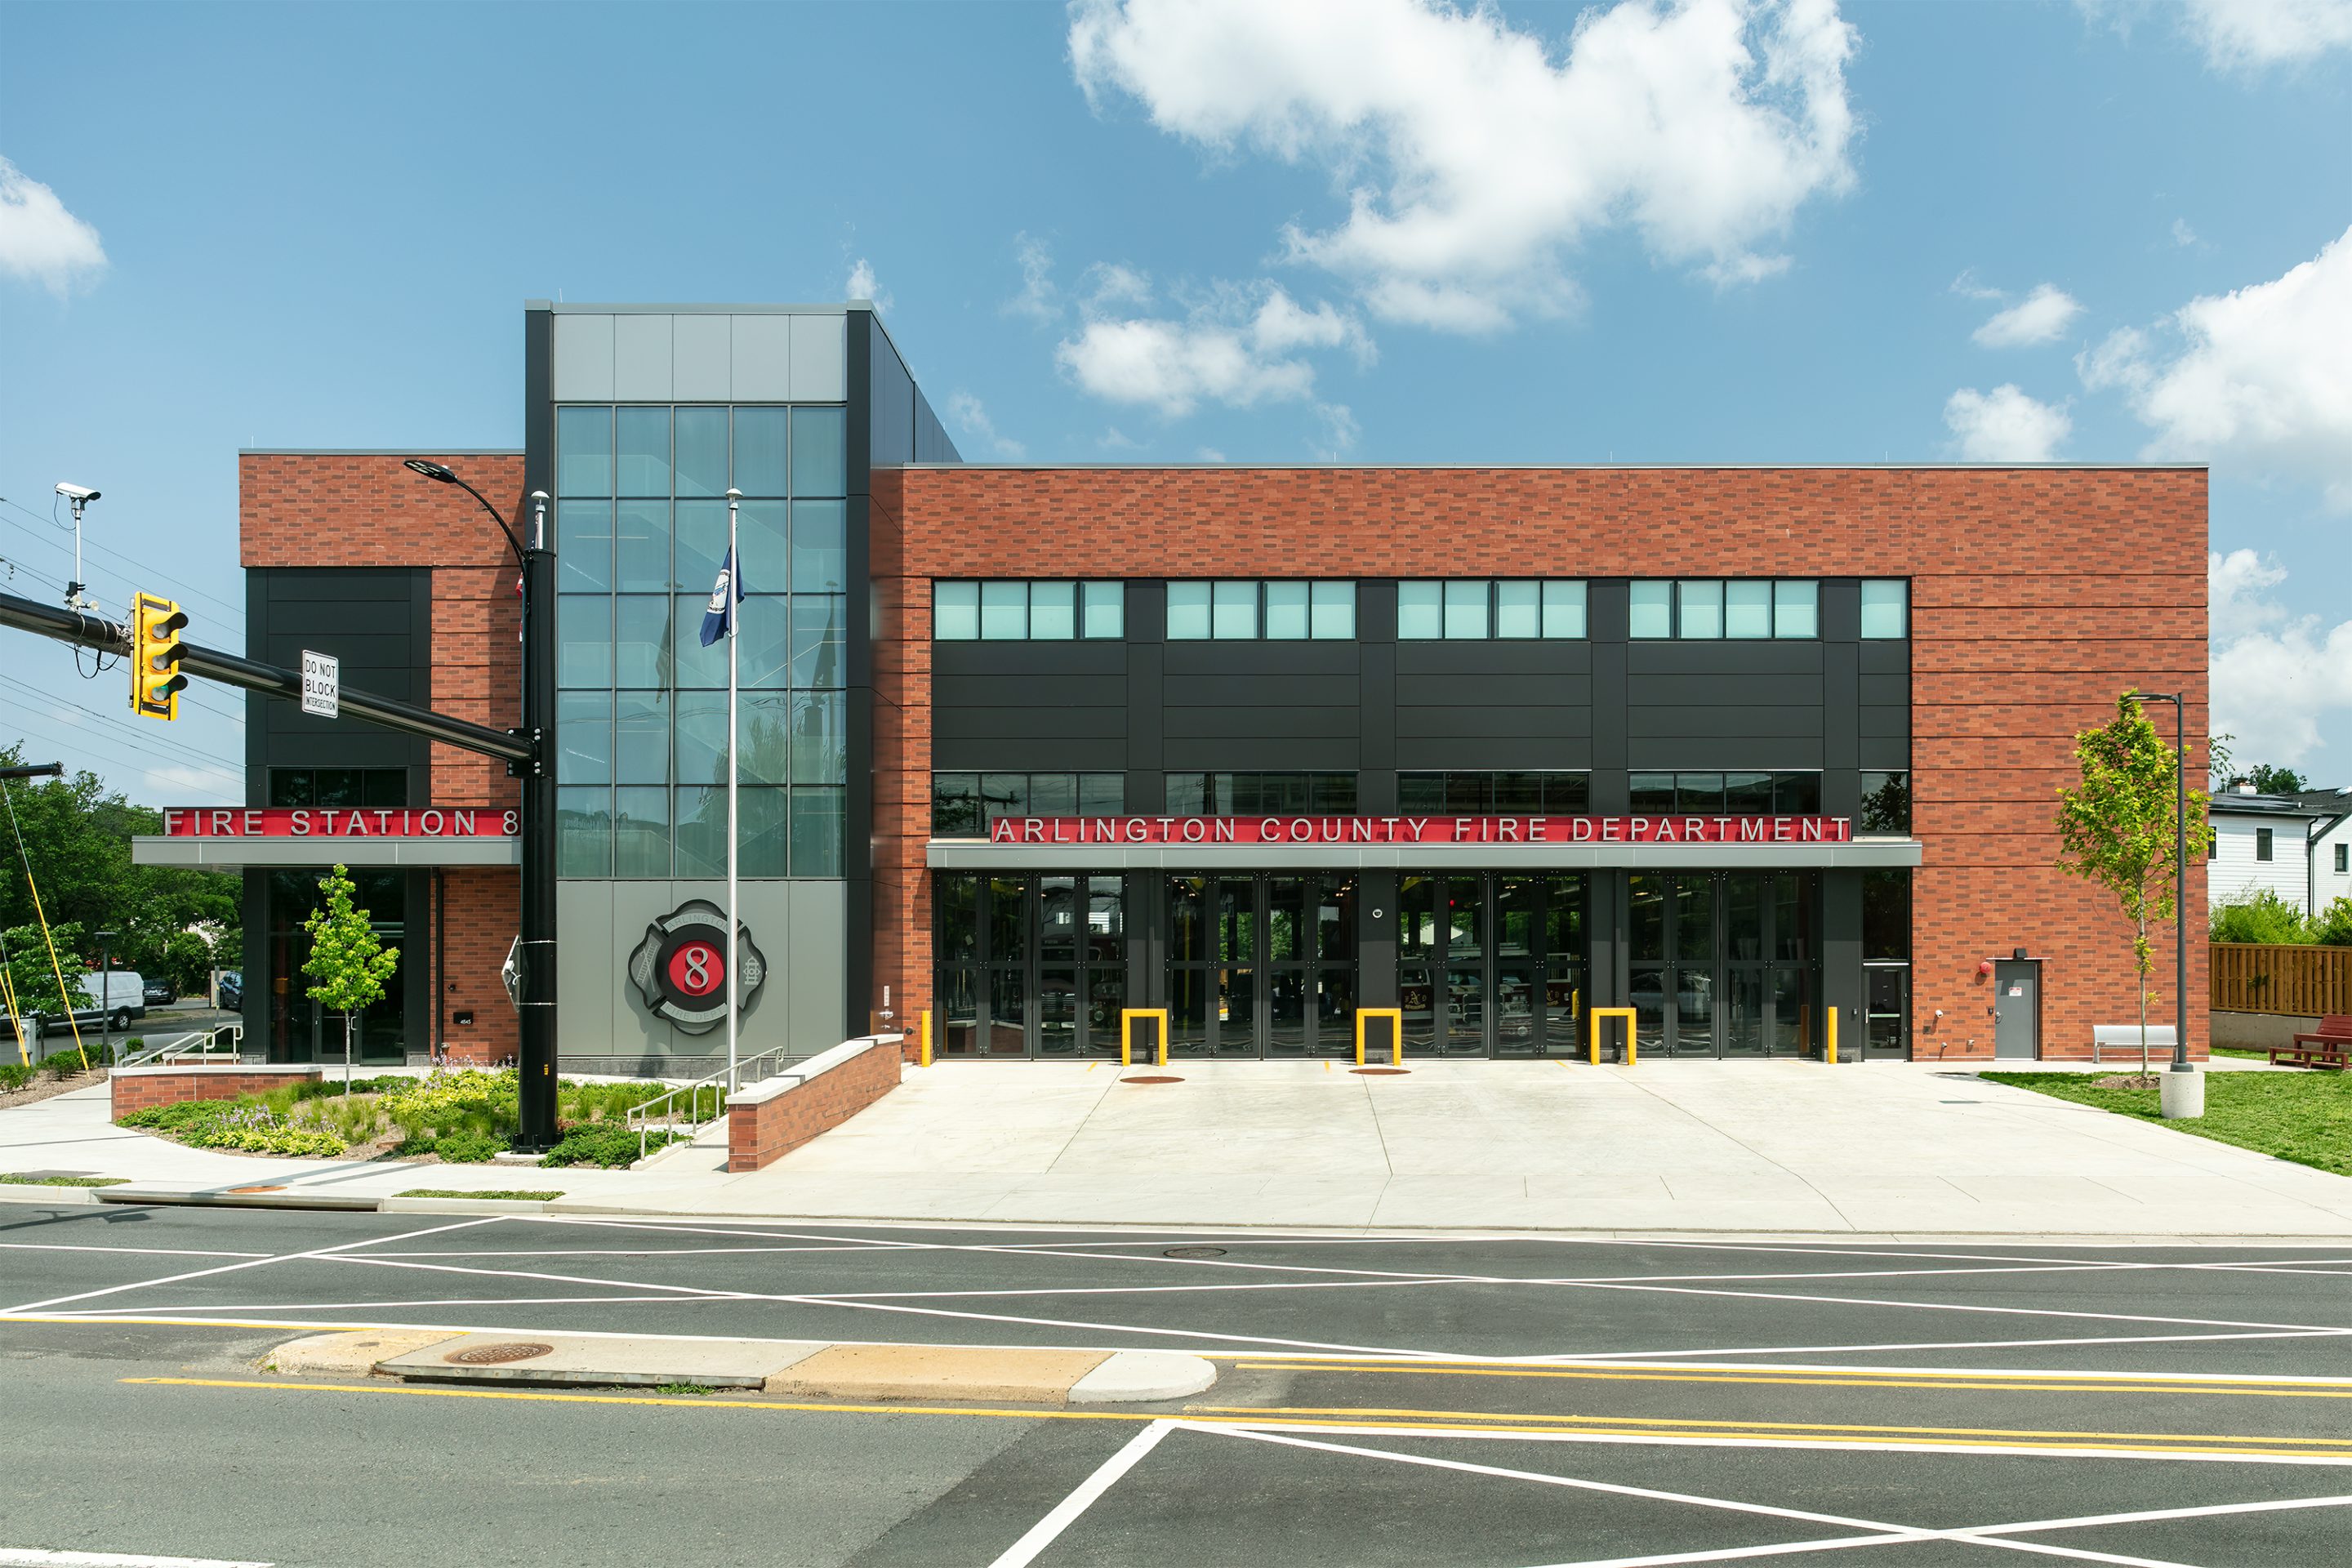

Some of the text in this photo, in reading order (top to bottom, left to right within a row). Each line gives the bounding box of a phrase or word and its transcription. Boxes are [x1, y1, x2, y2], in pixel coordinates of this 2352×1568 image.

[305, 659, 336, 679] DO NOT
[305, 679, 336, 698] BLOCK
[305, 696, 336, 710] INTERSECTION
[166, 810, 519, 835] FIRE STATION 8
[995, 817, 1850, 842] ARLINGTON COUNTY FIRE DEPARTMENT
[684, 947, 709, 988] 8
[665, 1004, 724, 1021] FIRE DEPT
